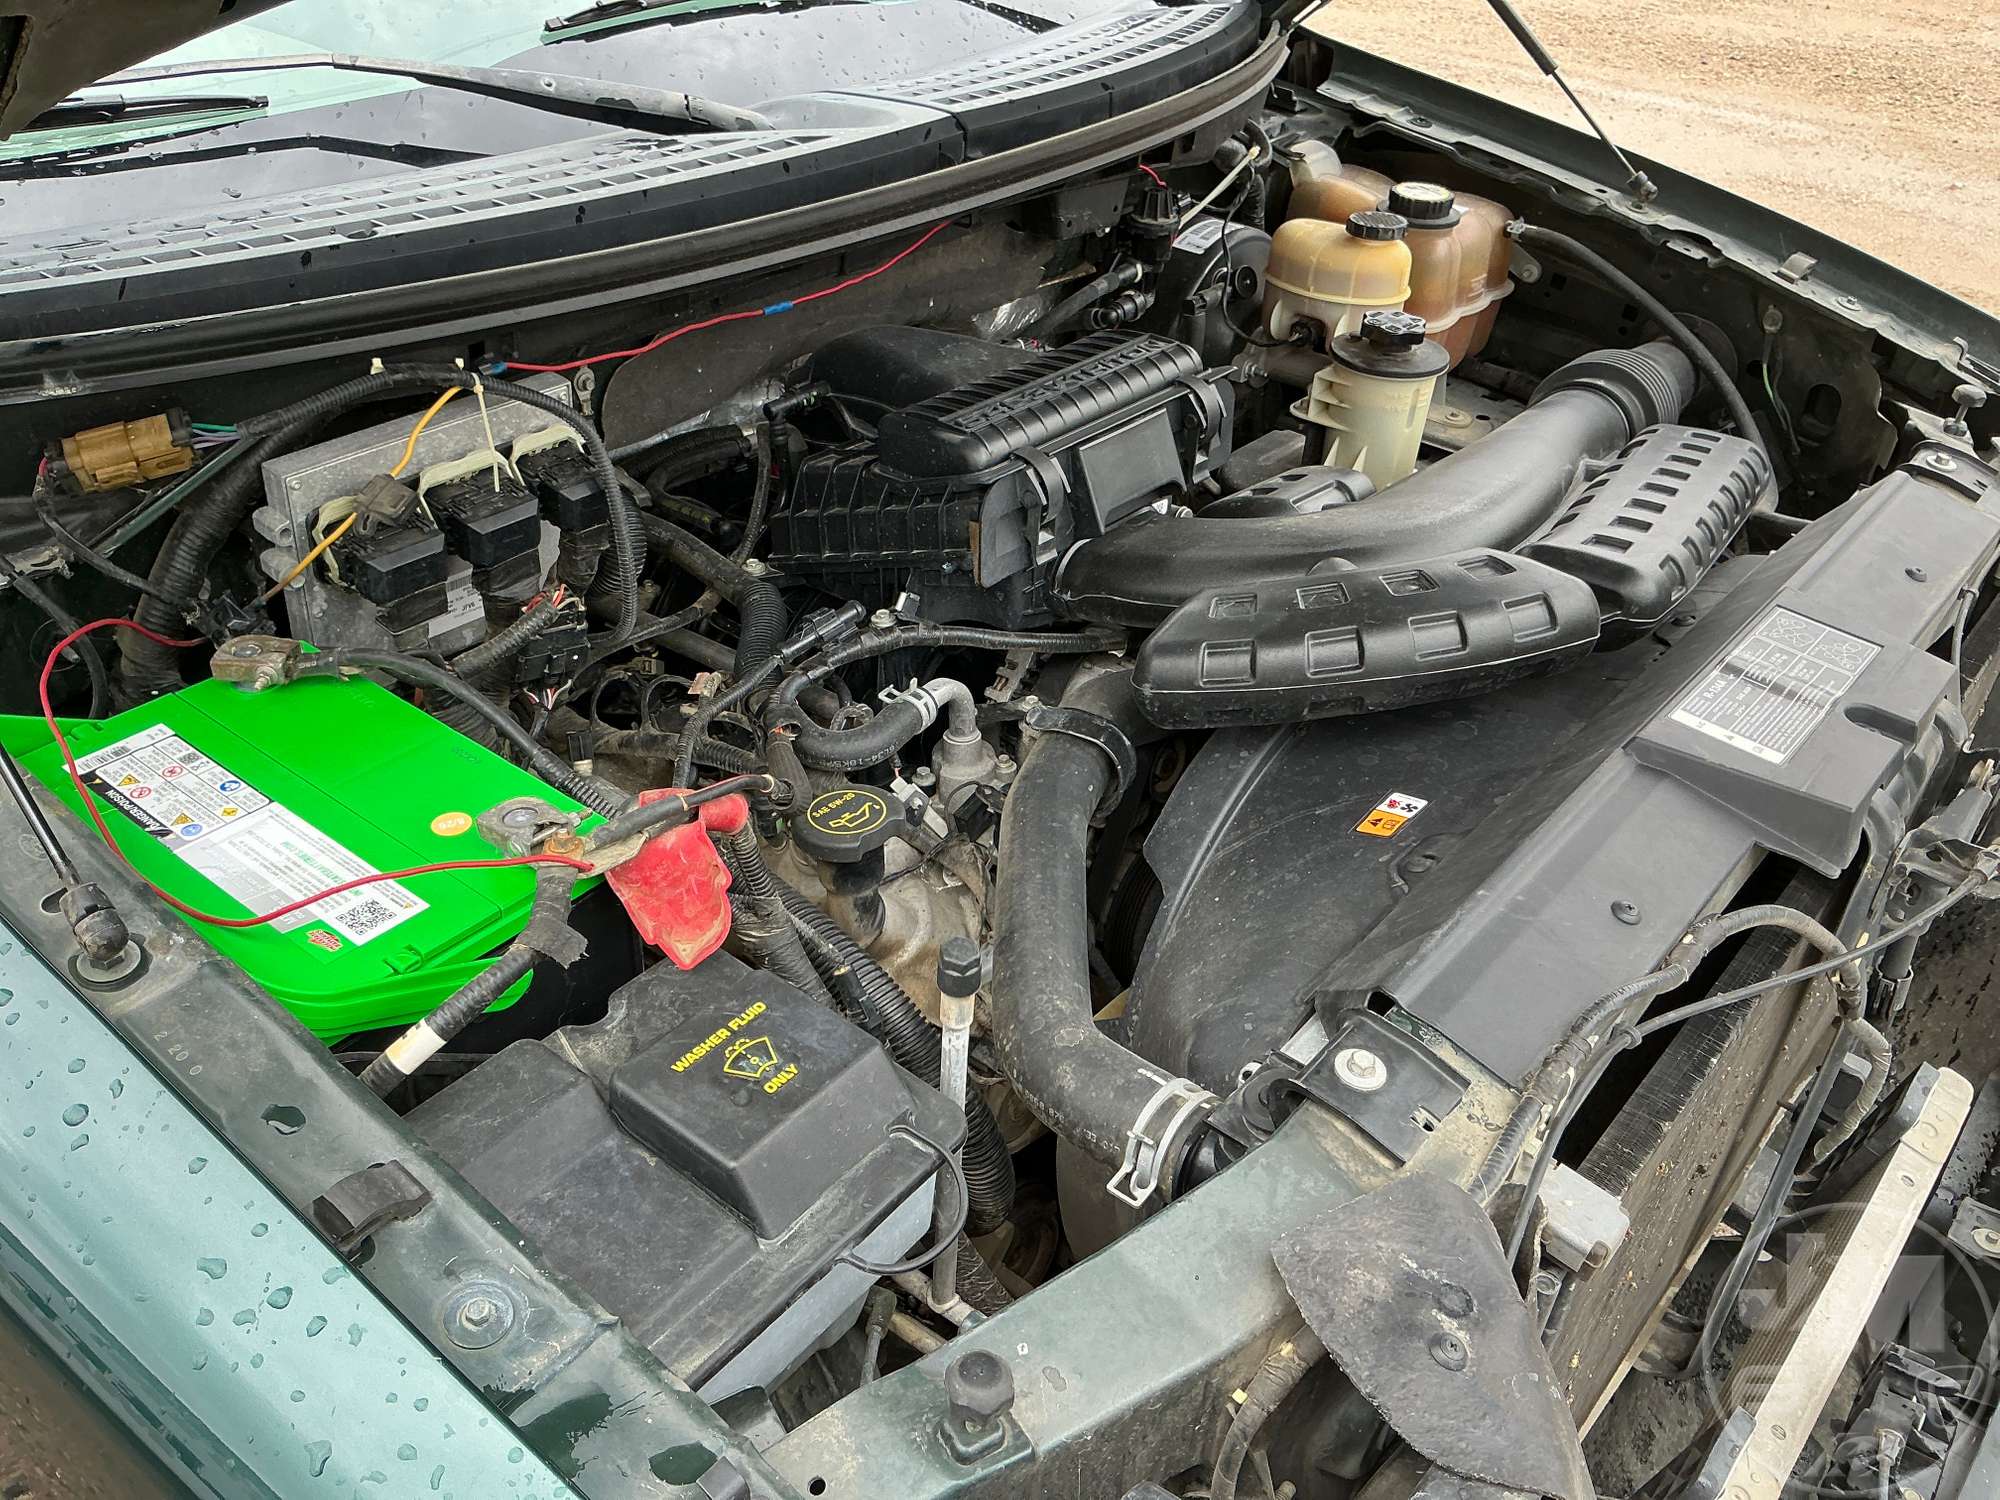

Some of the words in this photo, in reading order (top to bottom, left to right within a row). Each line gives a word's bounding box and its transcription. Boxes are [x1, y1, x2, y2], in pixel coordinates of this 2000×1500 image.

[812, 806, 831, 818] SAE
[827, 792, 856, 811] 5W-20
[671, 1028, 732, 1073] WASHER
[727, 1001, 768, 1031] FLUID
[763, 1063, 800, 1094] ONLY
